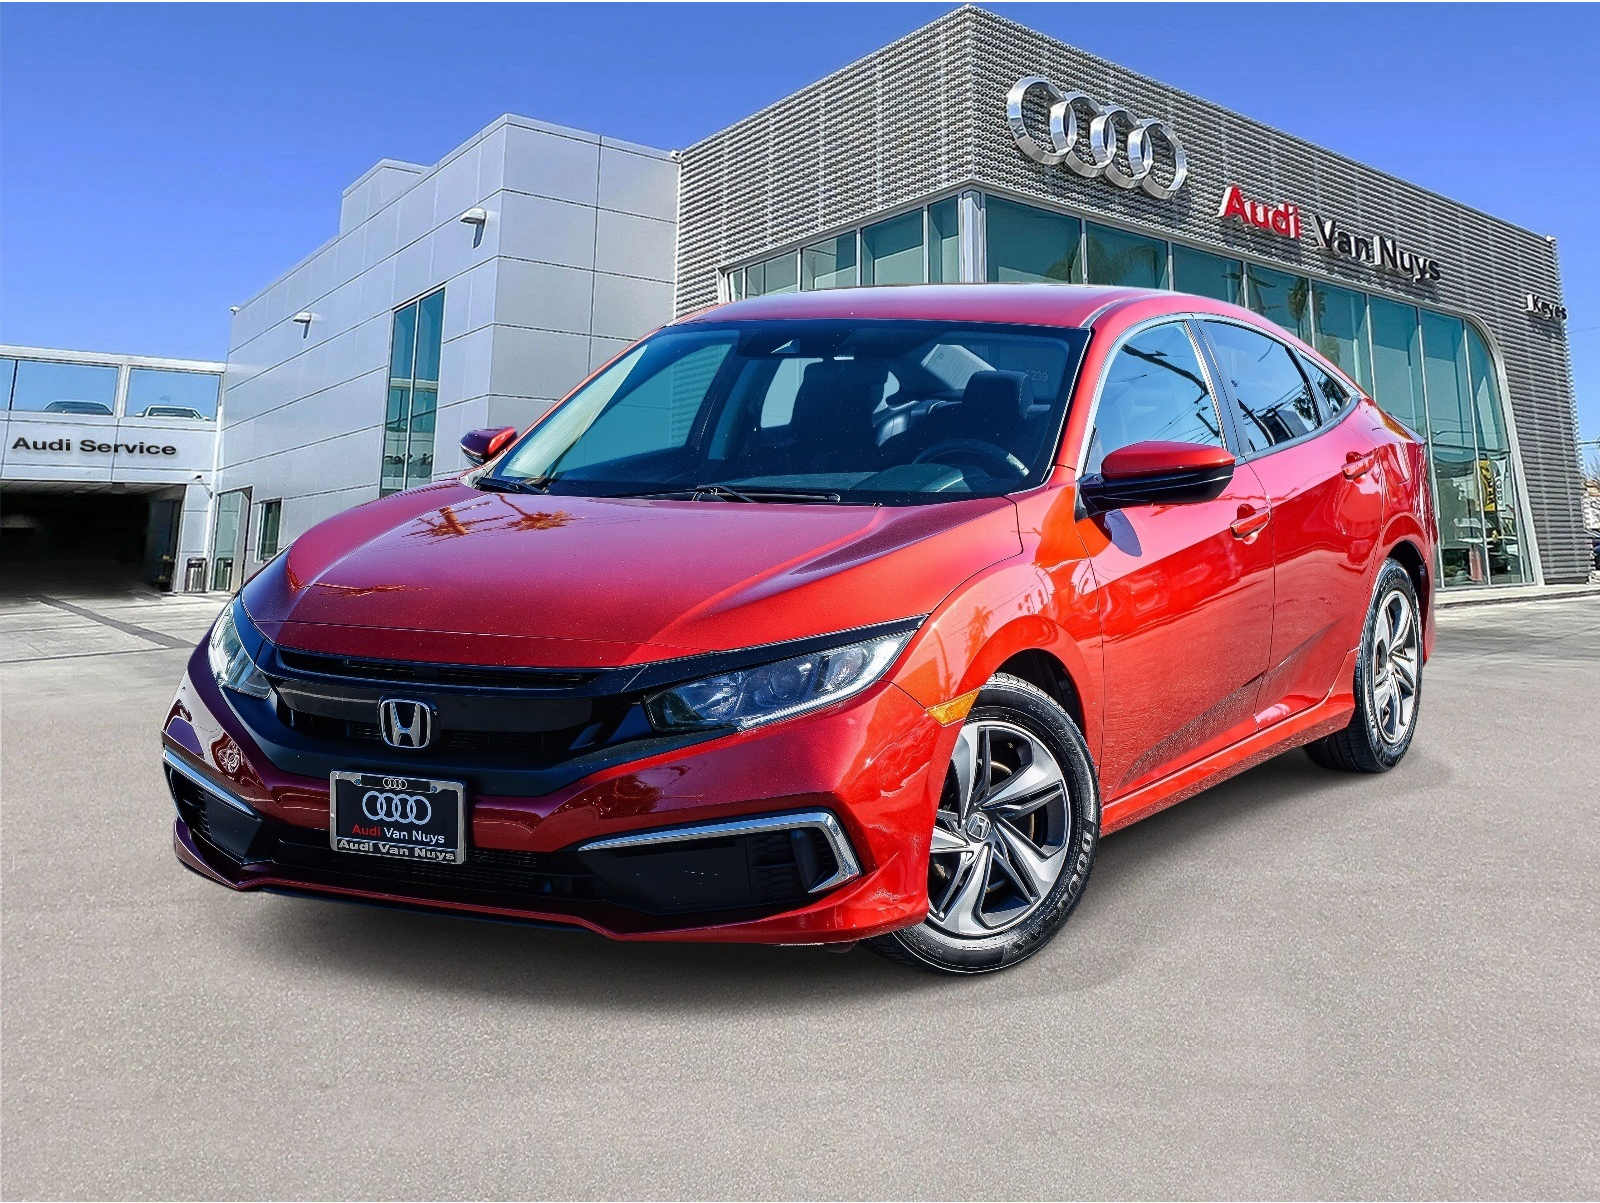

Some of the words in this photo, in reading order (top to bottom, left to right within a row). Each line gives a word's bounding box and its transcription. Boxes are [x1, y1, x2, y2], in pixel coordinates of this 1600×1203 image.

[1218, 182, 1302, 240] Audi
[1310, 214, 1373, 262] Van
[1374, 235, 1442, 285] Nuys
[1526, 293, 1568, 320] Keyes
[12, 436, 72, 452] Audi
[79, 438, 178, 456] Service
[351, 823, 381, 837] Audi
[383, 827, 409, 841] Van
[412, 830, 446, 845] Nuys
[338, 839, 374, 852] Audi
[378, 842, 410, 857] Van
[414, 847, 456, 861] Nuys
